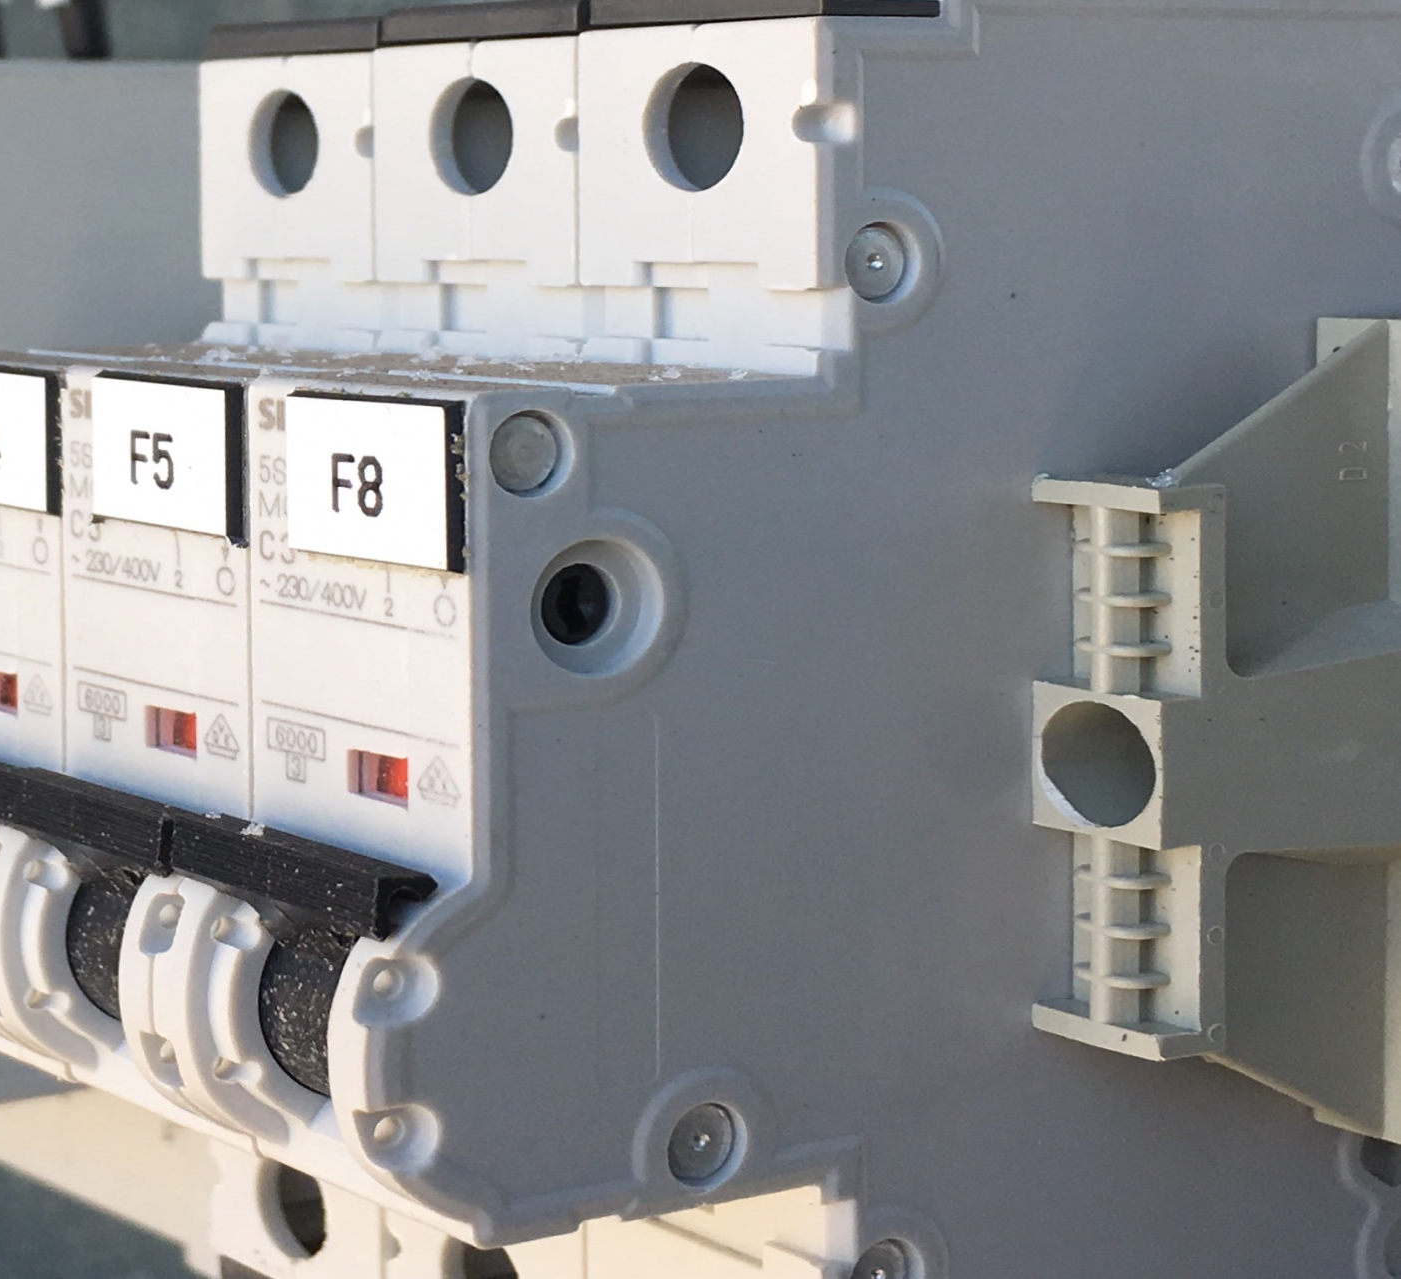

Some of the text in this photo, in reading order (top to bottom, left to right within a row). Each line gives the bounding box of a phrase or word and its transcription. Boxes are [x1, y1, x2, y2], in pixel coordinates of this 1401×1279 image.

[130, 429, 174, 490] F5
[331, 452, 383, 518] F8
[85, 687, 121, 715] 6000
[275, 724, 318, 754] 6000
